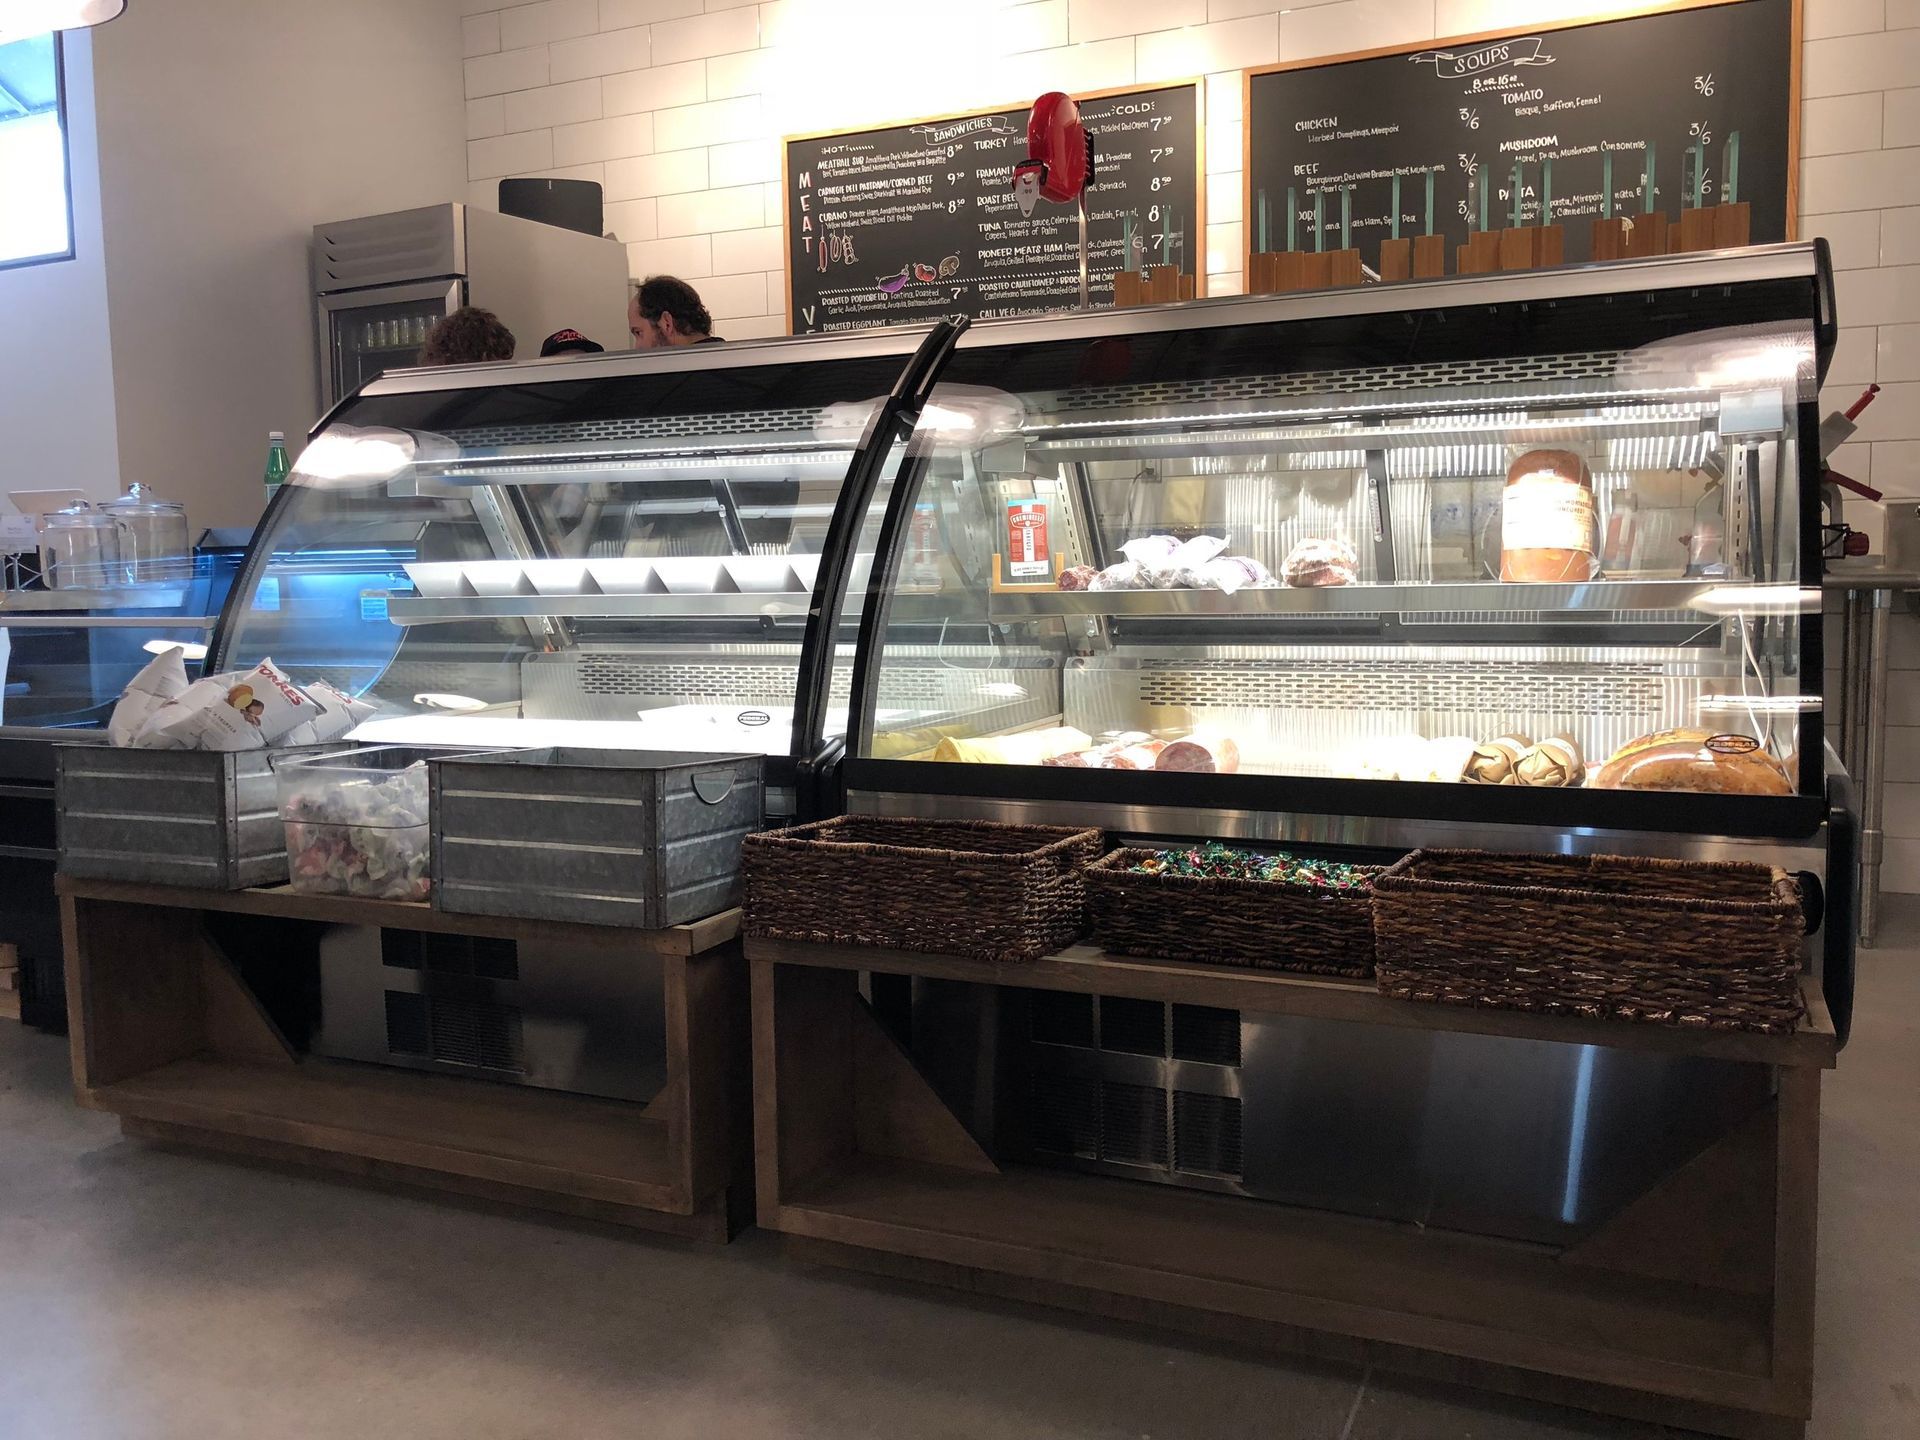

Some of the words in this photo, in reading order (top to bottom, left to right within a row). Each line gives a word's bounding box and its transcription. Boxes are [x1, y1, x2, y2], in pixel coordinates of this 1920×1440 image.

[1454, 45, 1510, 73] SOUPS
[1473, 78, 1481, 90] 8
[1694, 73, 1715, 97] 3/6
[1501, 88, 1544, 105] TOMATO
[1575, 94, 1602, 107] Fennel
[1116, 103, 1151, 115] COLD
[1295, 116, 1338, 132] CHICKEN
[1458, 107, 1480, 130] 3/6
[934, 117, 993, 142] SANDWICHES
[1689, 120, 1712, 145] 3/6
[824, 145, 845, 155] HOT
[973, 137, 1008, 151] TURKEY
[1499, 134, 1559, 153] MUSHROOM
[1560, 144, 1599, 158] Mushroom
[817, 158, 850, 170] MEATBALL
[1293, 162, 1320, 176] BEEF
[817, 185, 845, 197] CARNEGIE
[845, 183, 858, 193] DELI
[917, 174, 934, 186] BEEF
[1099, 180, 1127, 192] Spinach
[976, 194, 1001, 207] ROAST
[1002, 192, 1016, 204] BEE
[819, 211, 848, 223] CUBANO
[978, 222, 1001, 232] TUNA
[1031, 226, 1039, 236] of
[978, 247, 1013, 259] PIONEER
[1014, 244, 1042, 256] MEATS
[1043, 243, 1063, 253] HAM
[978, 281, 1010, 292] ROASTED
[1010, 277, 1055, 289] CAULIFLOWER
[821, 296, 850, 306] ROASTED
[851, 293, 888, 304] PORTOBELLO
[823, 322, 851, 333] ROASTED
[852, 318, 887, 329] EGGPLANT
